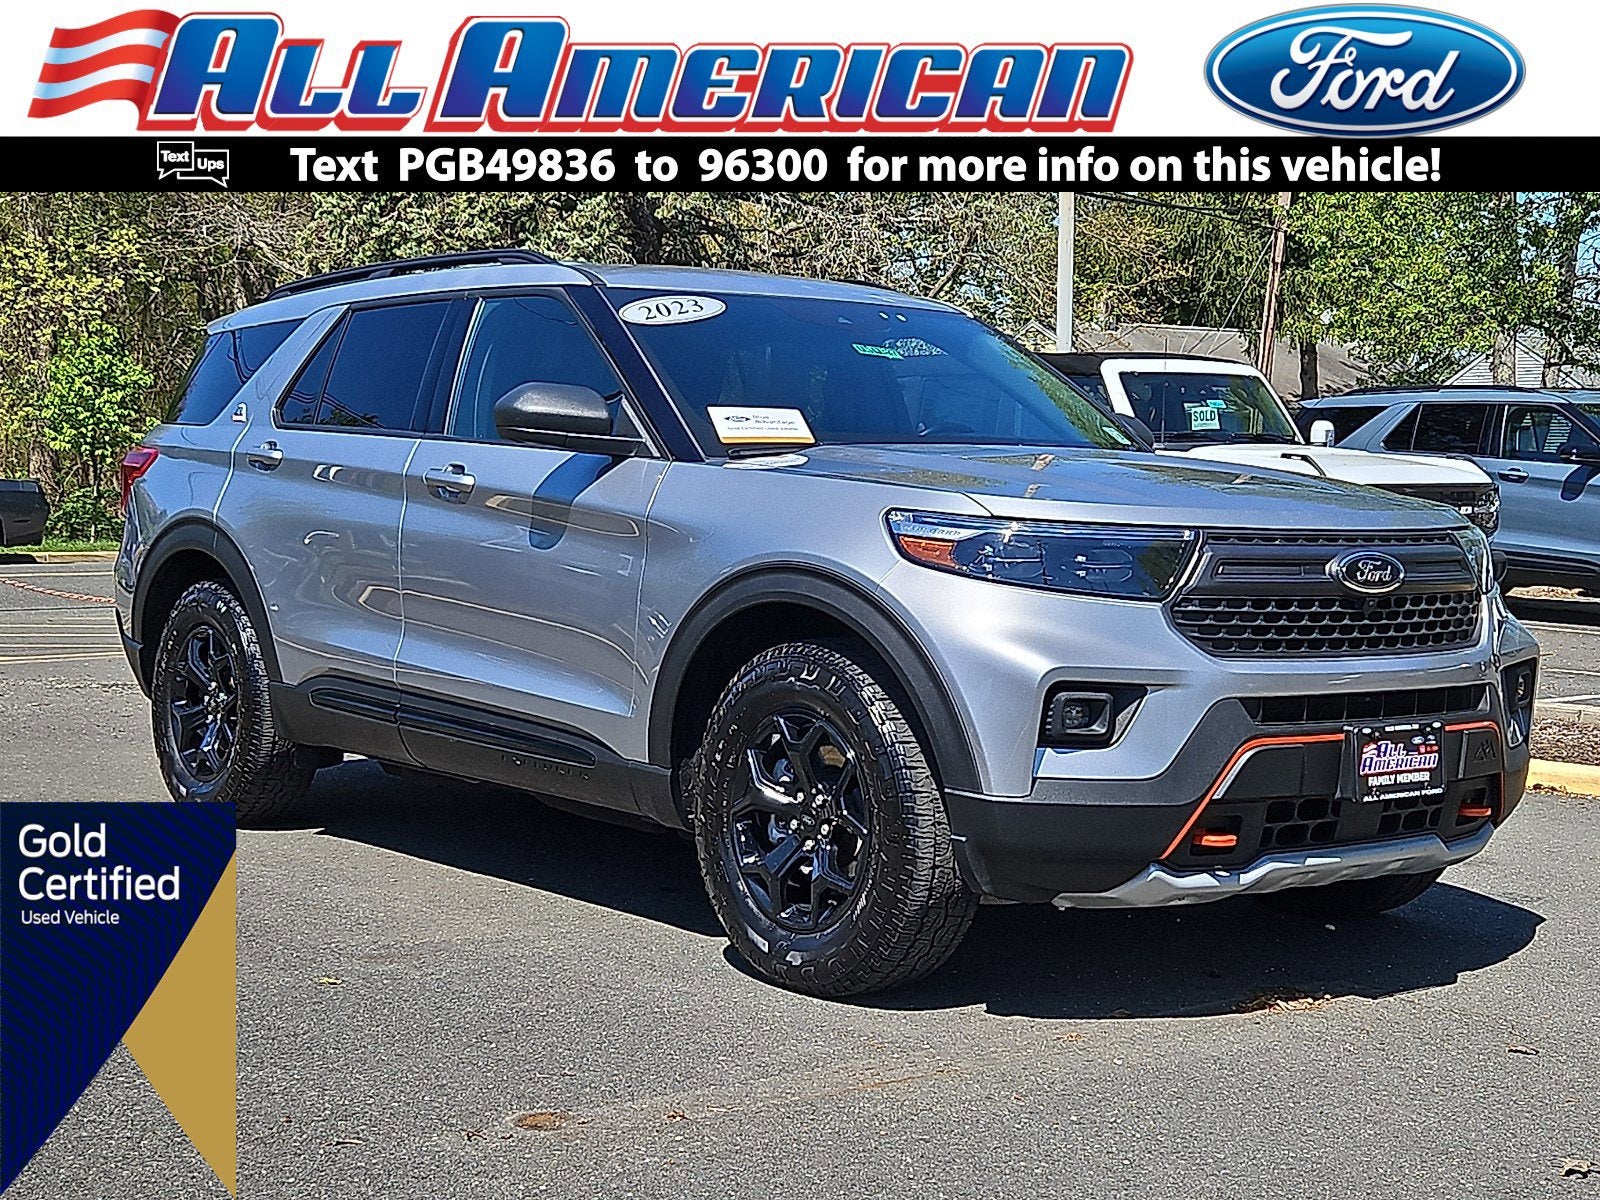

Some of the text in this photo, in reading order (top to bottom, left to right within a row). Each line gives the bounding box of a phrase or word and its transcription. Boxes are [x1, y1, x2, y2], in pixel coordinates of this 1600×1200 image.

[637, 299, 704, 321] 2023
[1193, 410, 1216, 422] SOLD
[1356, 560, 1393, 582] Ford
[1368, 771, 1430, 787] FAMILY MEMBER
[1380, 790, 1421, 800] AMERICAN
[1422, 788, 1444, 796] FORD
